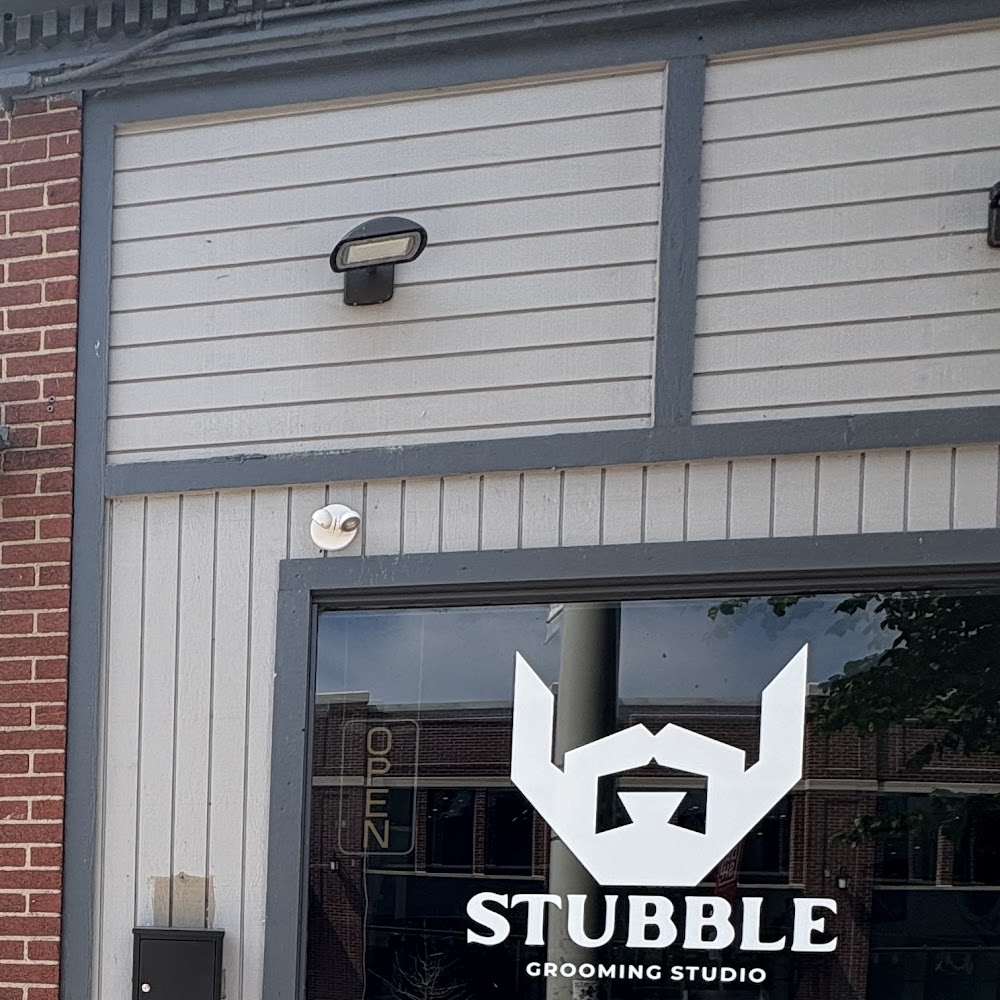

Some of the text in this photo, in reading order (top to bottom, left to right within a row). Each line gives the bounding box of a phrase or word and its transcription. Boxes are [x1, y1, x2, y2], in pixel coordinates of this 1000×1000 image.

[363, 726, 393, 849] OPEN
[466, 892, 838, 953] STUBBLE
[525, 962, 767, 983] GROOMING STUDIO
